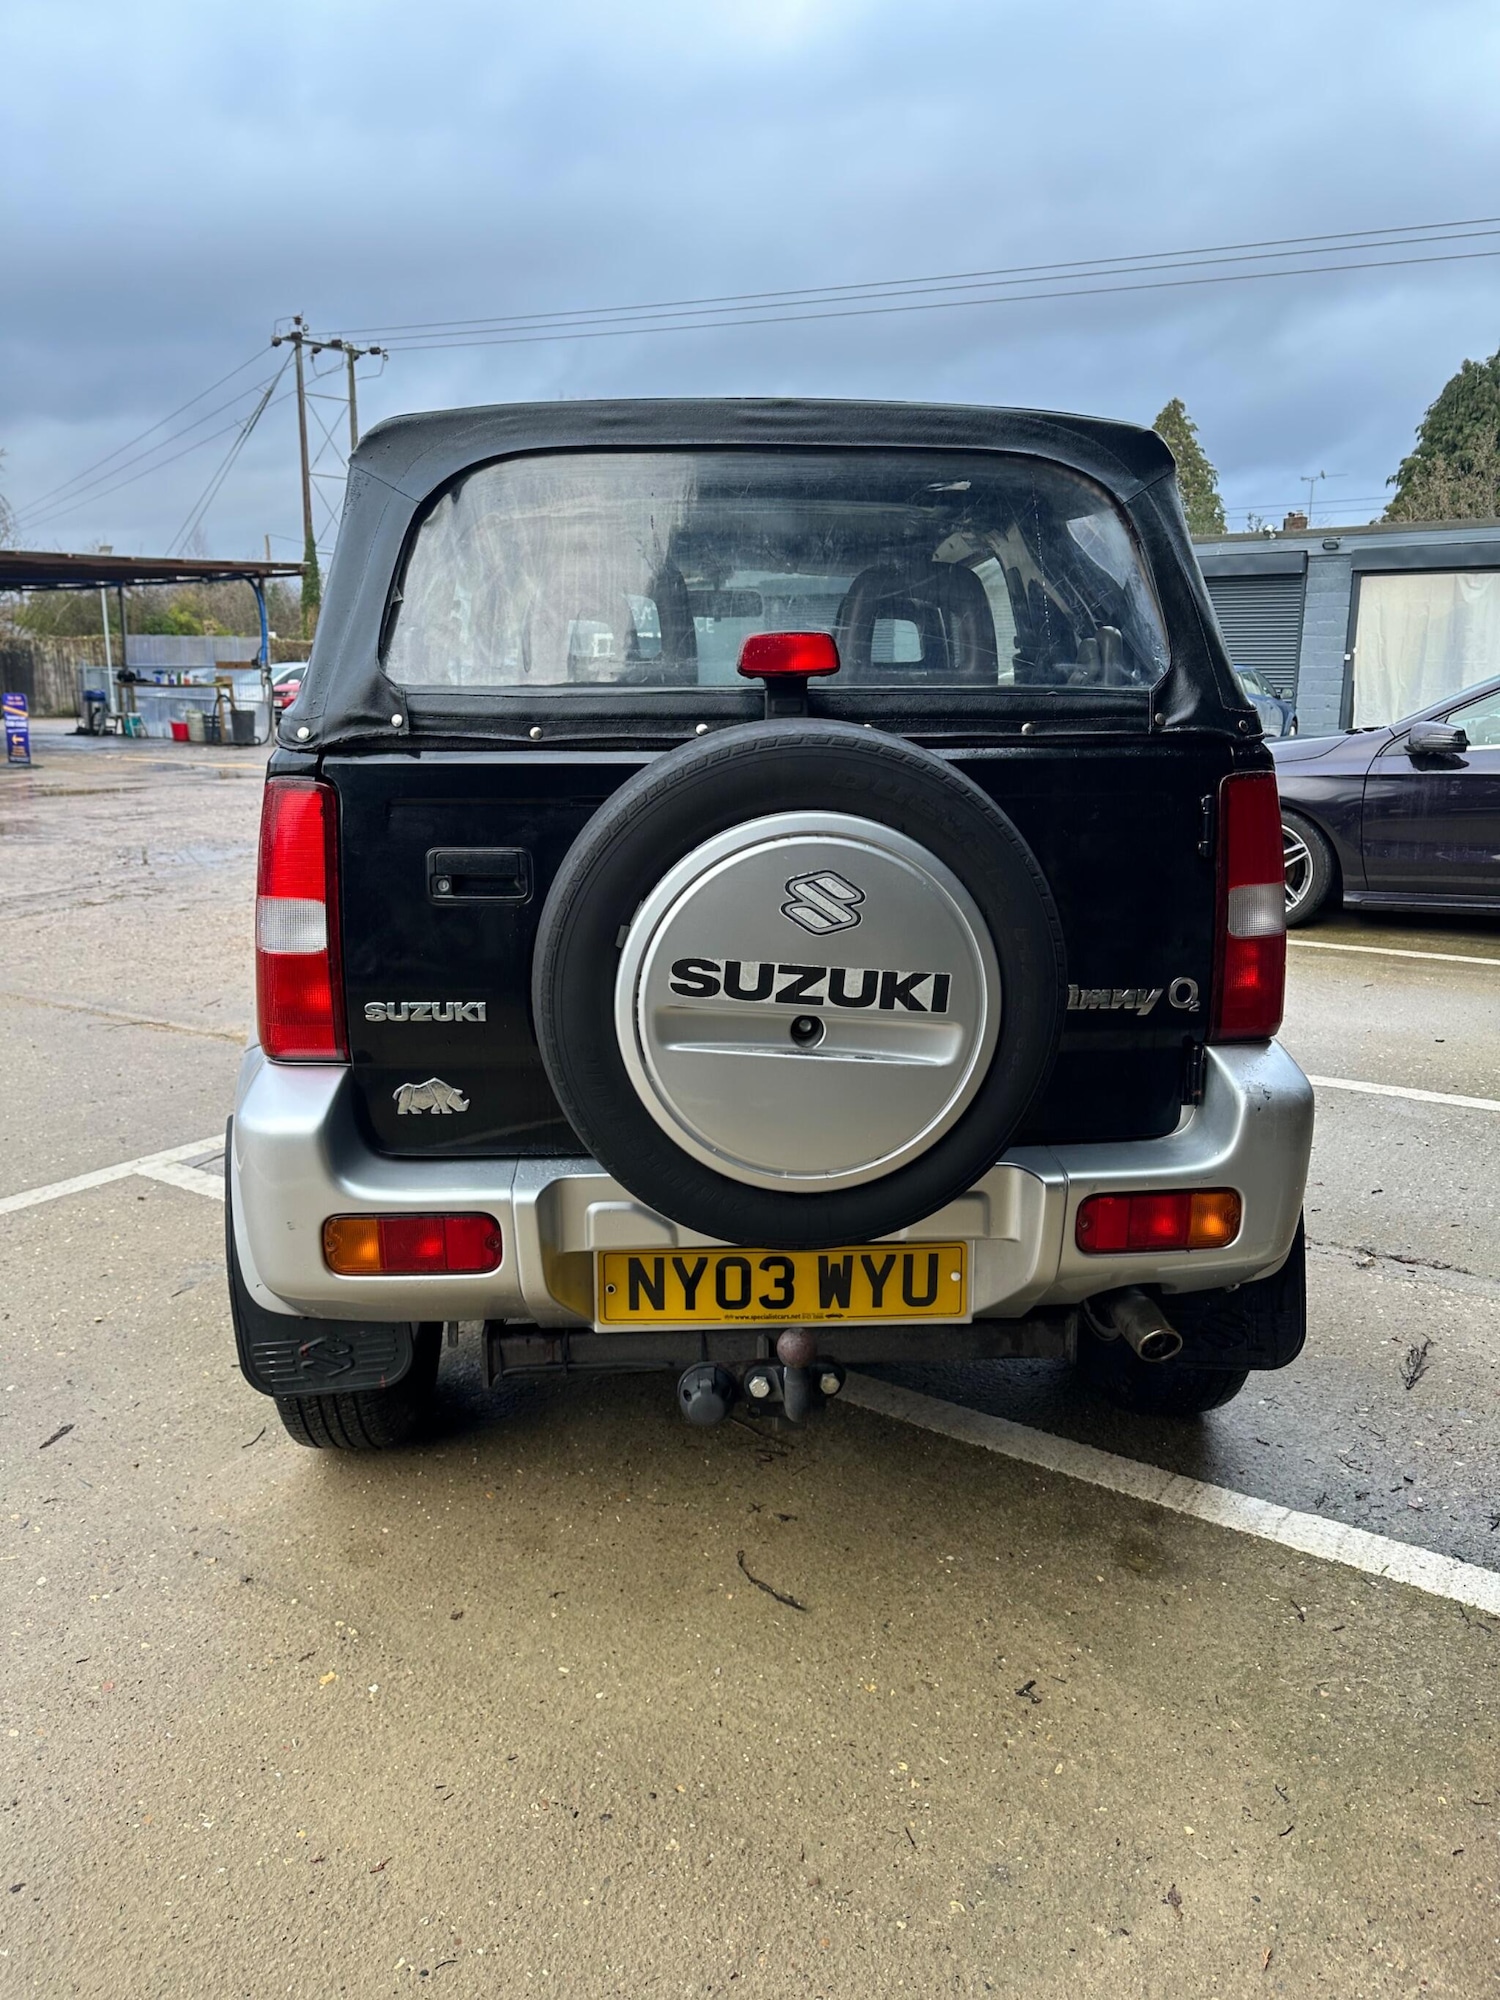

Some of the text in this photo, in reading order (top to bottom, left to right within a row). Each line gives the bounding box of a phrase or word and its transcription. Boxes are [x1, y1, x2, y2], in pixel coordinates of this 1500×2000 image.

[670, 958, 951, 1013] SUZUKI
[1066, 984, 1164, 1016] imny
[364, 1001, 487, 1022] SUZUKI
[628, 1252, 939, 1311] NY03 WYU
